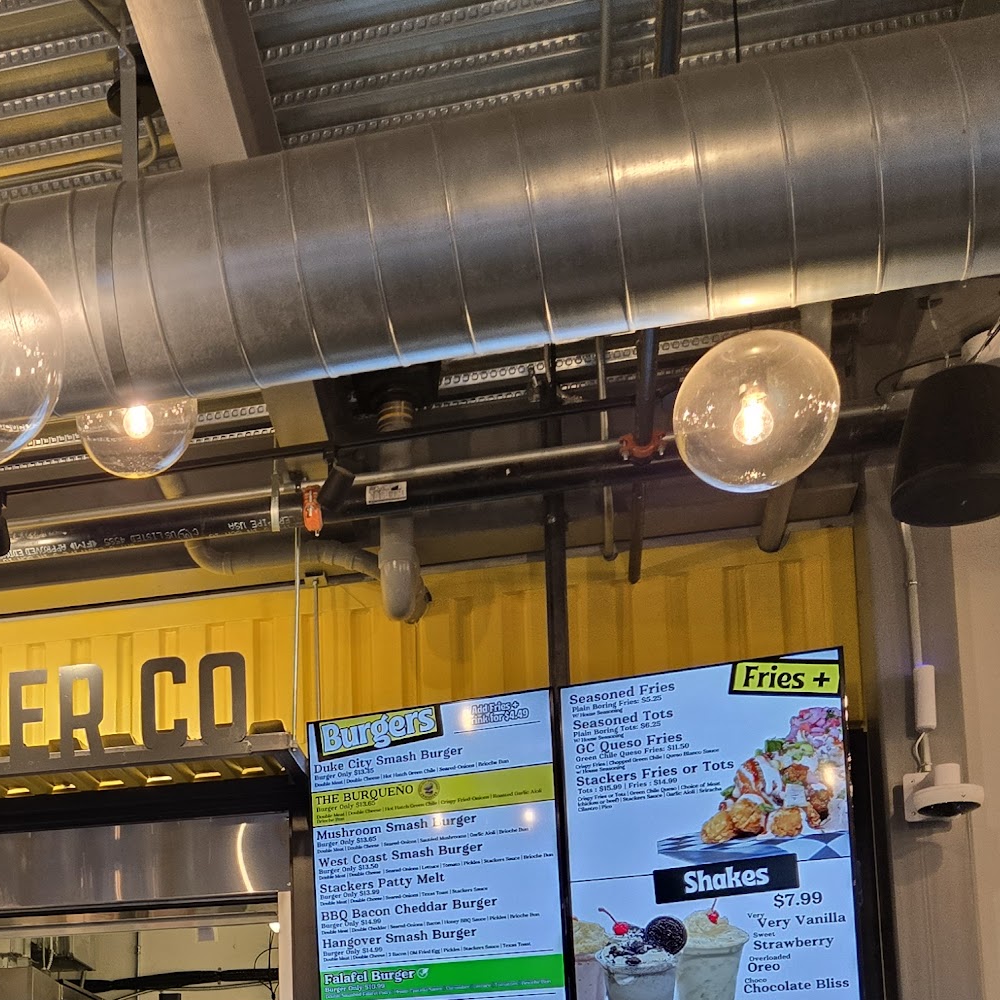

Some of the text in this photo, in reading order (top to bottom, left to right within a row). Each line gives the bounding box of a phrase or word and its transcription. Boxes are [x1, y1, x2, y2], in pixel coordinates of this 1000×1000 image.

[743, 665, 830, 689] Fries +
[140, 651, 247, 750] CO
[570, 682, 675, 704] Seasoned Fries
[471, 704, 487, 715] Add
[489, 701, 510, 713] Fries
[472, 708, 529, 725] rink for $4.49
[321, 707, 435, 753] Burgers
[573, 712, 638, 729] Seasoned
[643, 710, 673, 720] Tots
[576, 733, 682, 754] GC Queso Fries
[314, 747, 462, 774] Duke City Smash Burger
[599, 751, 617, 759] Chile
[620, 750, 641, 758] Queso
[577, 771, 636, 786] Stackers
[642, 766, 677, 779] Fries
[683, 764, 697, 773] or
[703, 760, 734, 771] Tots
[316, 794, 339, 805] THE
[344, 784, 413, 801] BURQUEÑO
[317, 826, 381, 840] Mushroom
[386, 819, 427, 832] Smash
[319, 857, 348, 867] West
[353, 852, 387, 864] Coast
[392, 847, 433, 860] Smash
[439, 843, 482, 856] Burger
[319, 867, 340, 875] Burger
[684, 866, 769, 894] Shakes
[320, 872, 445, 893] Stackers Patty Melt
[320, 892, 341, 900] Burger
[774, 891, 822, 908] $7.99
[321, 897, 497, 922] BBQ Bacon Cheddar Burger
[757, 912, 846, 929] Very Vanilla
[323, 928, 476, 949] Hangover Smash Burger
[754, 937, 834, 950] Strawberry
[748, 963, 780, 972] Oreo
[749, 953, 790, 961] Overloaded
[324, 969, 414, 984] Falafel Burger
[744, 978, 849, 993] Chocolate Bliss
